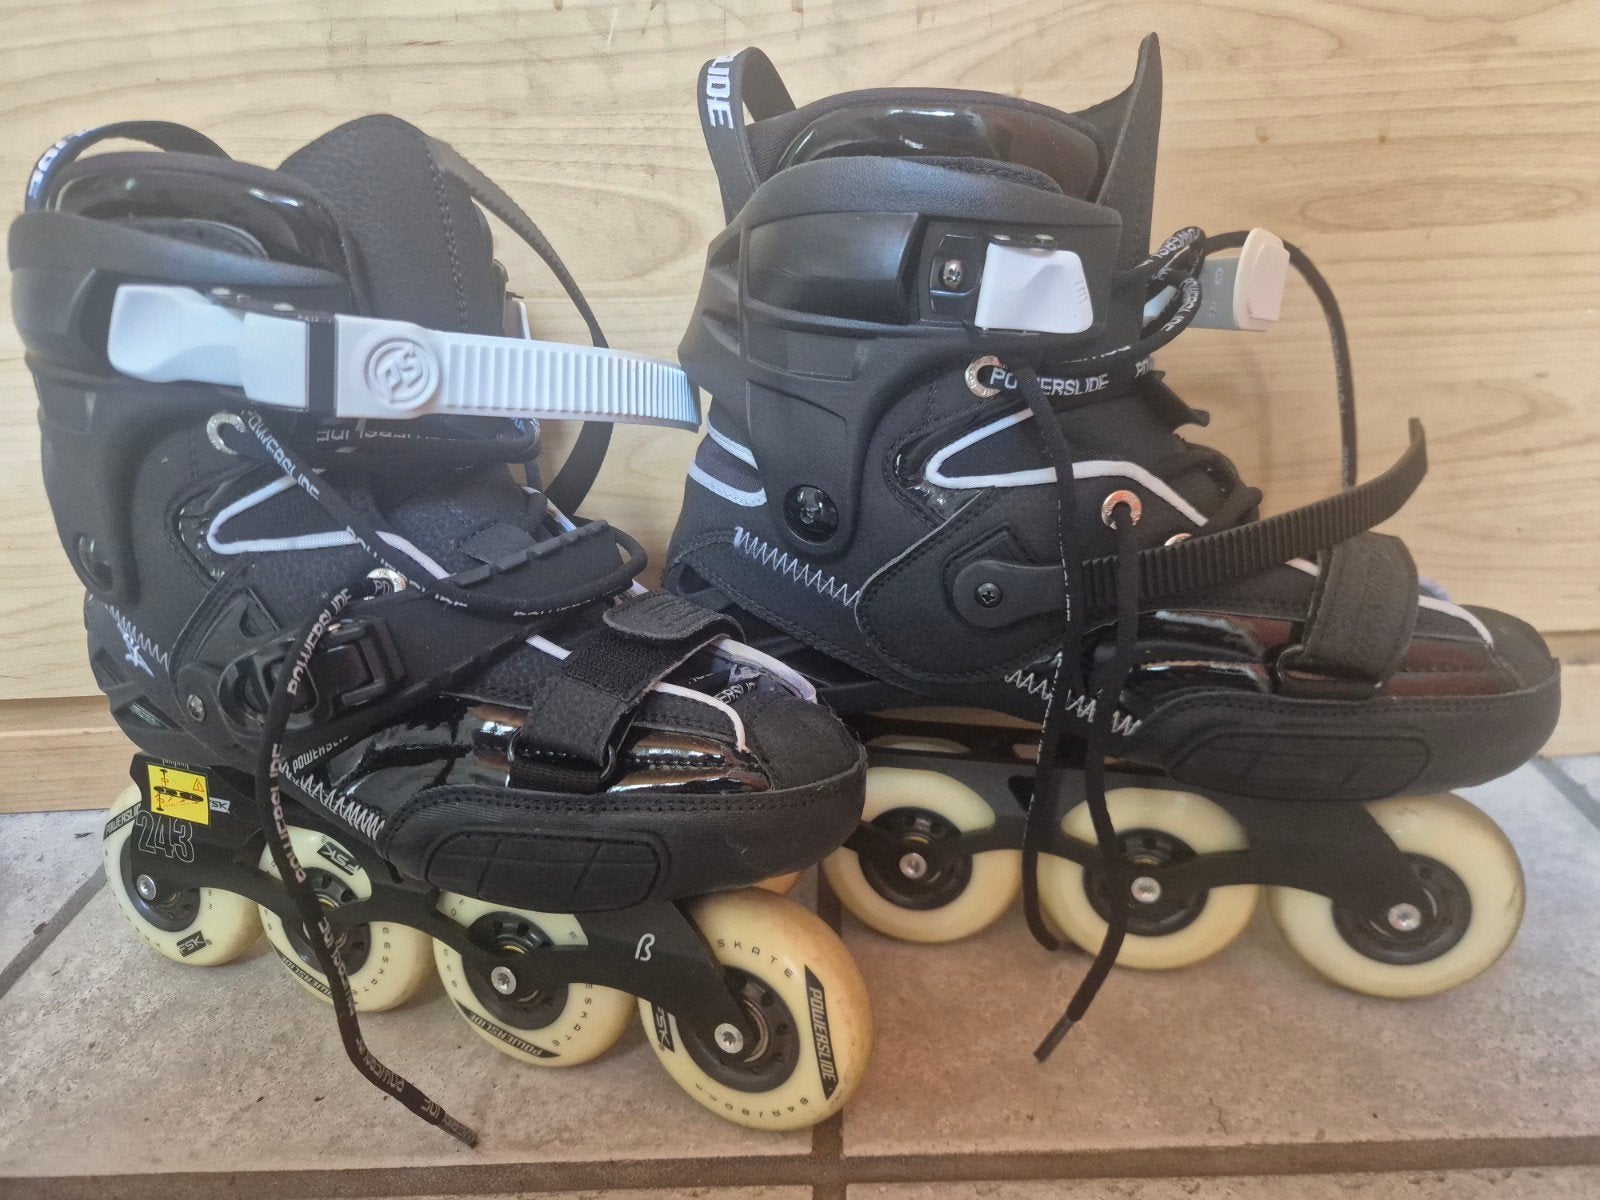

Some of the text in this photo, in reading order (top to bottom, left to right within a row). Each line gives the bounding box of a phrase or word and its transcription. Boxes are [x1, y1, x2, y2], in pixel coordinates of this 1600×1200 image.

[989, 367, 1110, 397] POERSLIDE
[209, 799, 229, 811] SK
[136, 810, 195, 863] 243
[324, 846, 361, 875] FSK
[177, 936, 205, 954] FSK
[470, 1014, 543, 1056] POWERSLIDE
[809, 986, 836, 1083] POWERSLIDE
